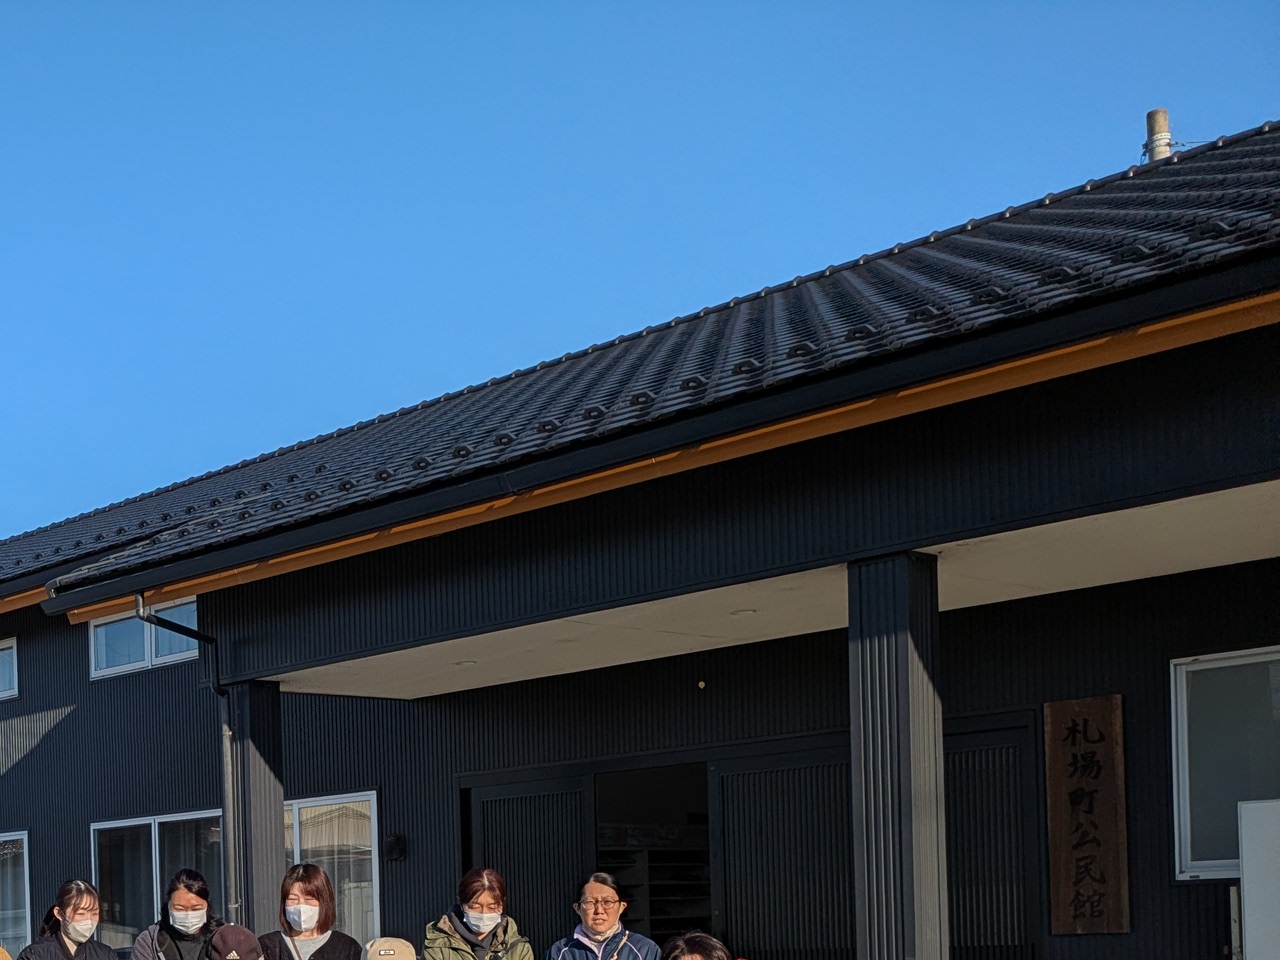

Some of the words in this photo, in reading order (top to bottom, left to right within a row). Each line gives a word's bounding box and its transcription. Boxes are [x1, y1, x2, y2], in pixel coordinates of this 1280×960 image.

[1062, 717, 1106, 920] 札場町公民館
